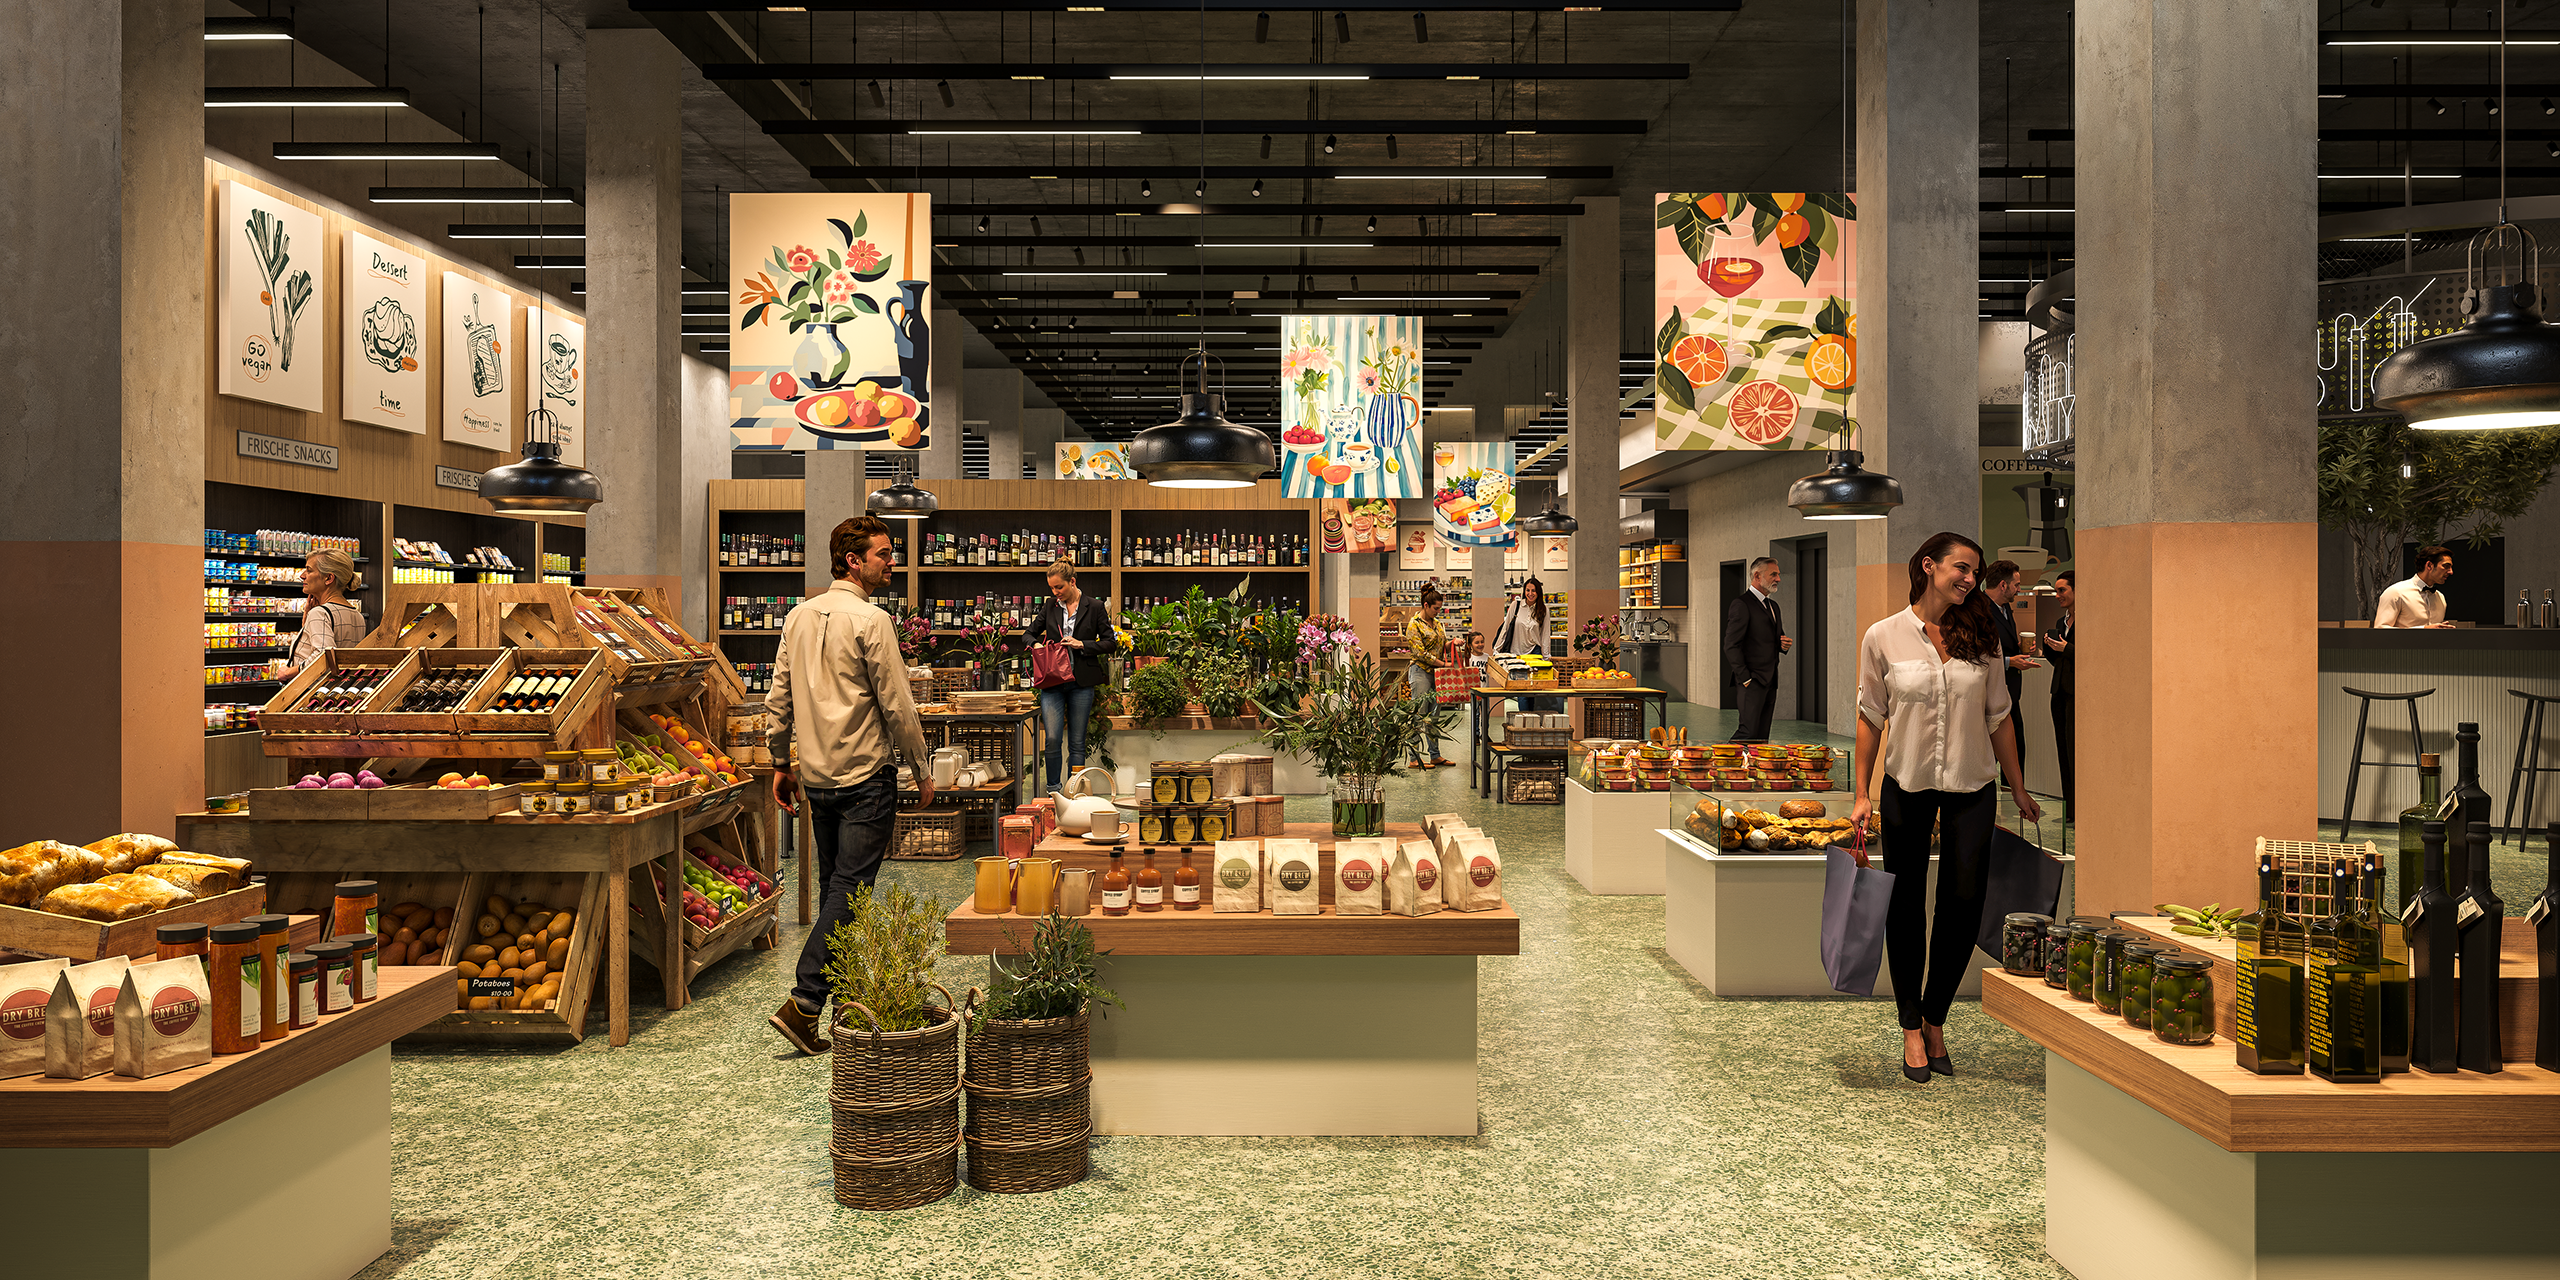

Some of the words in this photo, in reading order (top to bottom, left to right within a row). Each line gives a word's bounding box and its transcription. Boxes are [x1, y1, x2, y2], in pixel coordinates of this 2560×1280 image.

[373, 252, 408, 280] Dessert
[248, 341, 266, 357] GO
[242, 357, 272, 377] vegan
[380, 390, 402, 410] time
[247, 436, 290, 459] FRISCHE
[294, 444, 332, 465] SNACKS
[442, 470, 471, 487] FRISCHE
[472, 979, 511, 987] Potatoes
[3, 1009, 23, 1022] DRY
[27, 1006, 46, 1020] BRE
[91, 1007, 106, 1020] DRY
[154, 1007, 171, 1020] DRY
[173, 1001, 198, 1016] BREW
